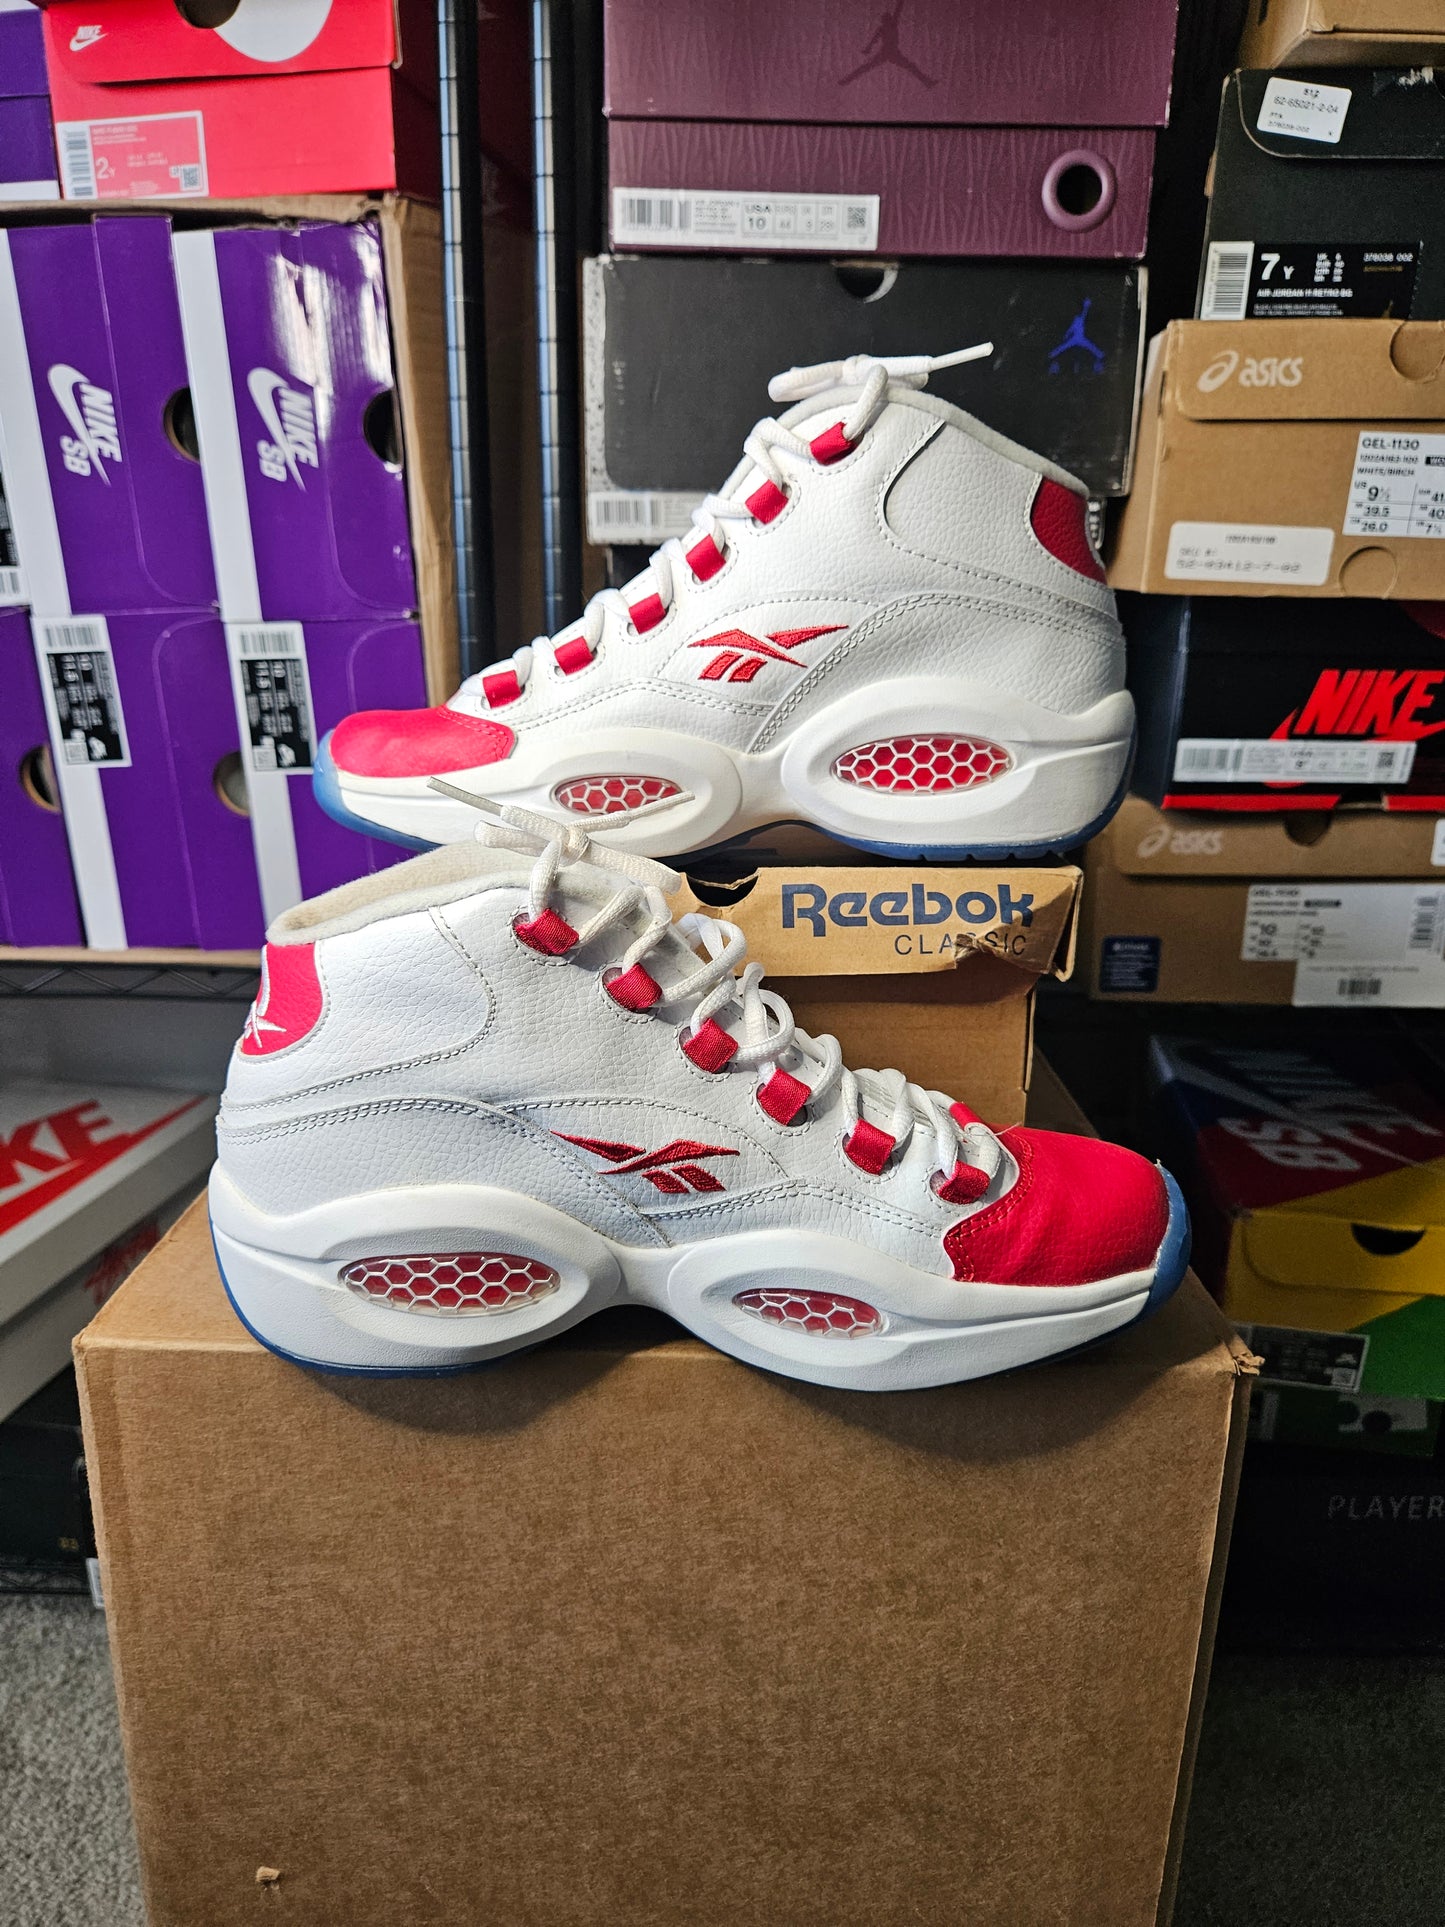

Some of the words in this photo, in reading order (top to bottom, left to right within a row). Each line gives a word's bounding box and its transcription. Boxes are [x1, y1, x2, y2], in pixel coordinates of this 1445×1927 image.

[745, 203, 771, 214] USA
[748, 216, 766, 230] 10
[1256, 288, 1272, 298] AIR
[1272, 288, 1304, 298] JORDAN
[1312, 288, 1341, 298] RETRO
[1239, 356, 1303, 388] asics
[79, 382, 123, 463] NIKE
[277, 387, 320, 469] NIKE
[59, 434, 92, 477] SB
[256, 438, 288, 482] SB
[1362, 437, 1420, 451] GEL-1130
[1293, 669, 1445, 735] NIKE
[1171, 830, 1223, 855] asics
[781, 882, 1034, 938] Reebok
[894, 930, 1027, 956] CLASIC
[1217, 1116, 1363, 1172] SB
